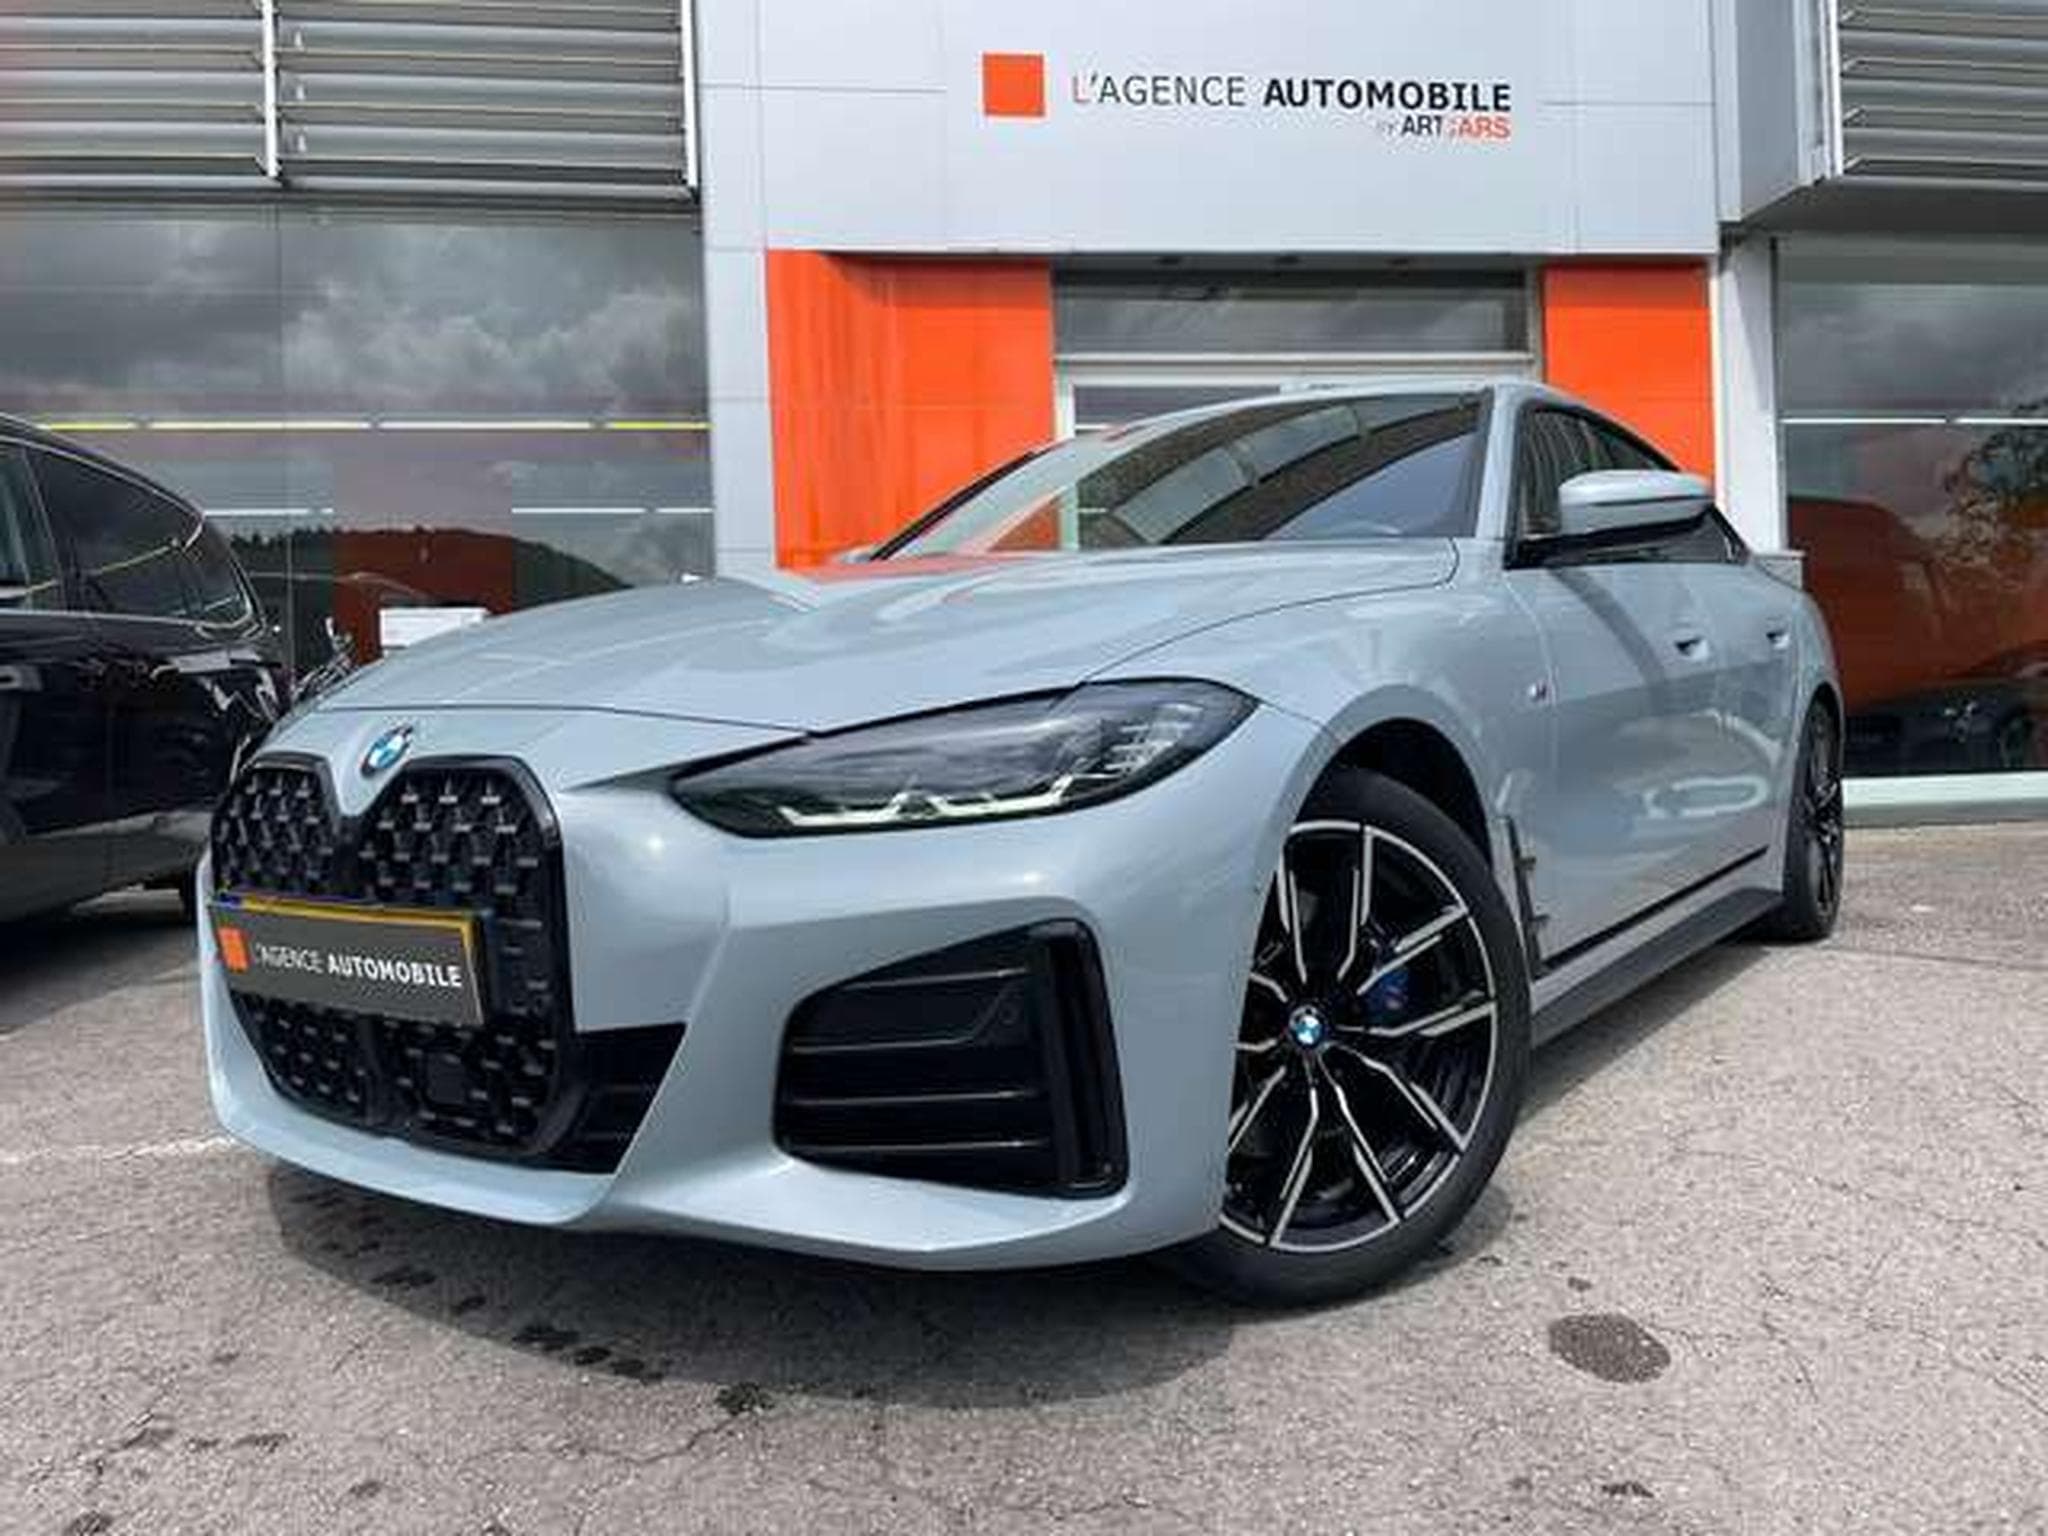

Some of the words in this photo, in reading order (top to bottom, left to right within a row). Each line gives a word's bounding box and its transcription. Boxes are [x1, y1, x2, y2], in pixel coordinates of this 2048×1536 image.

[1072, 71, 1246, 107] L'AGENCE
[1263, 77, 1512, 112] AUTOMOBILE
[253, 942, 324, 974] 'AGENCE
[327, 952, 463, 988] AUTOMOBILE
